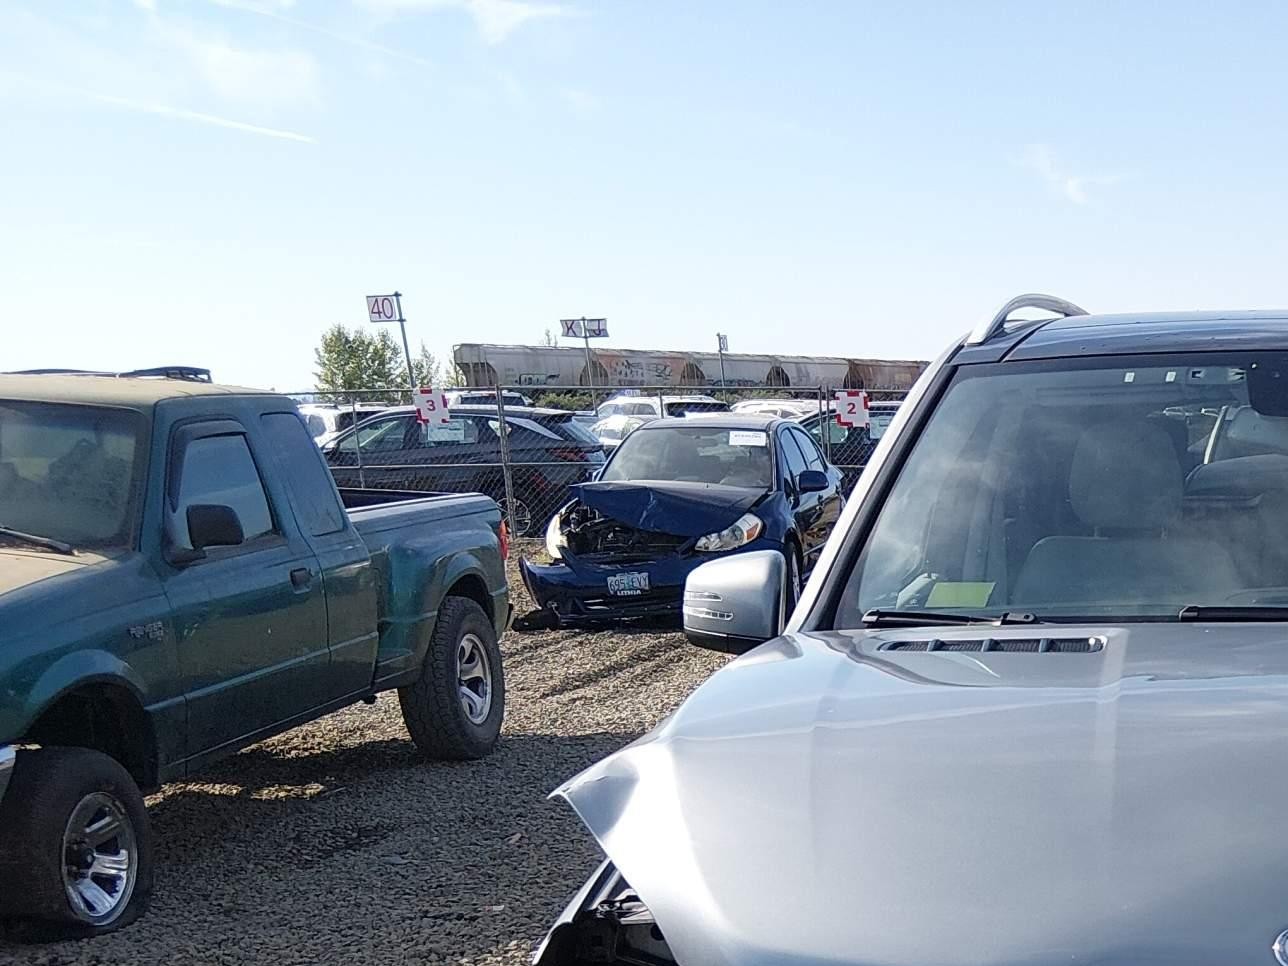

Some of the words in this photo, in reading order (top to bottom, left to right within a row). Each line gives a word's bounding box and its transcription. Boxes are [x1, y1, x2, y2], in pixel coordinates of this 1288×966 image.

[371, 298, 394, 319] 40
[565, 320, 577, 336] K
[593, 319, 602, 336] J
[426, 400, 436, 412] 3
[847, 402, 857, 415] 2
